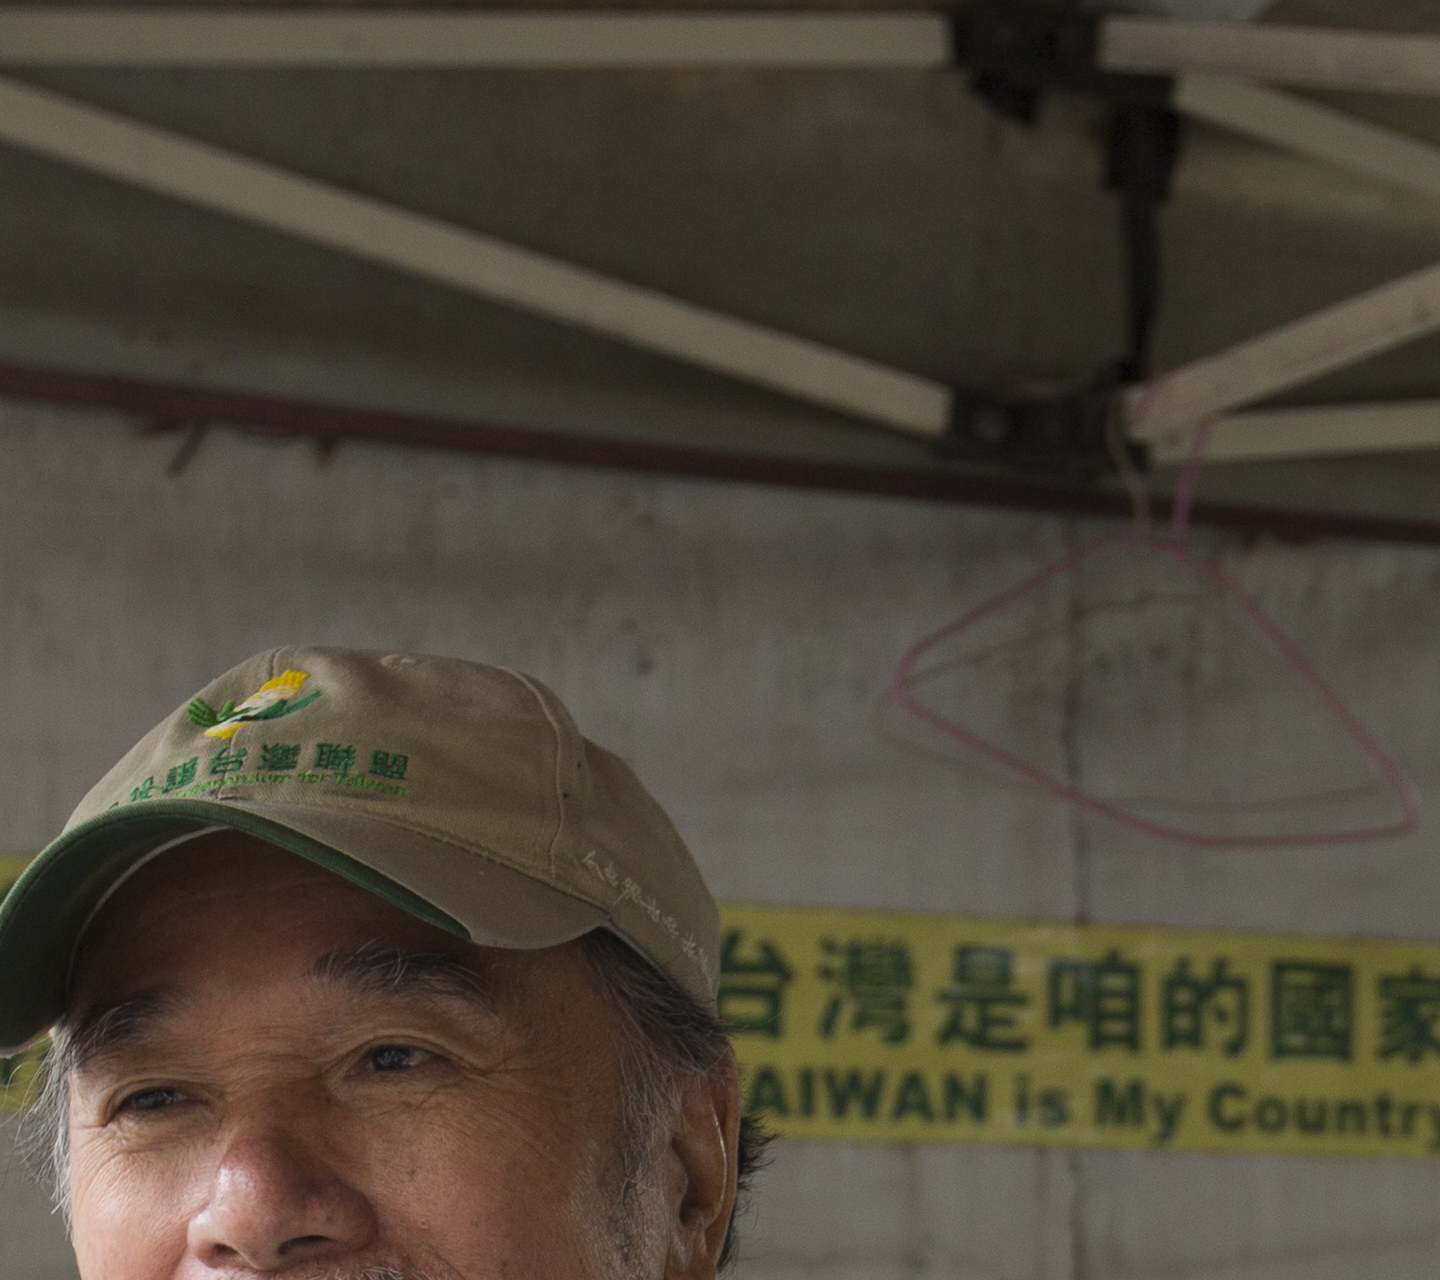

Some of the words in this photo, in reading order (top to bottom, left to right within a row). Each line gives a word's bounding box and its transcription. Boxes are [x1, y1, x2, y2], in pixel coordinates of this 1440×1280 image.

[110, 743, 409, 810] 投護台灣聯盟
[741, 1060, 991, 1127] AIWAN
[1012, 1074, 1074, 1130] is
[1091, 1077, 1189, 1148] My
